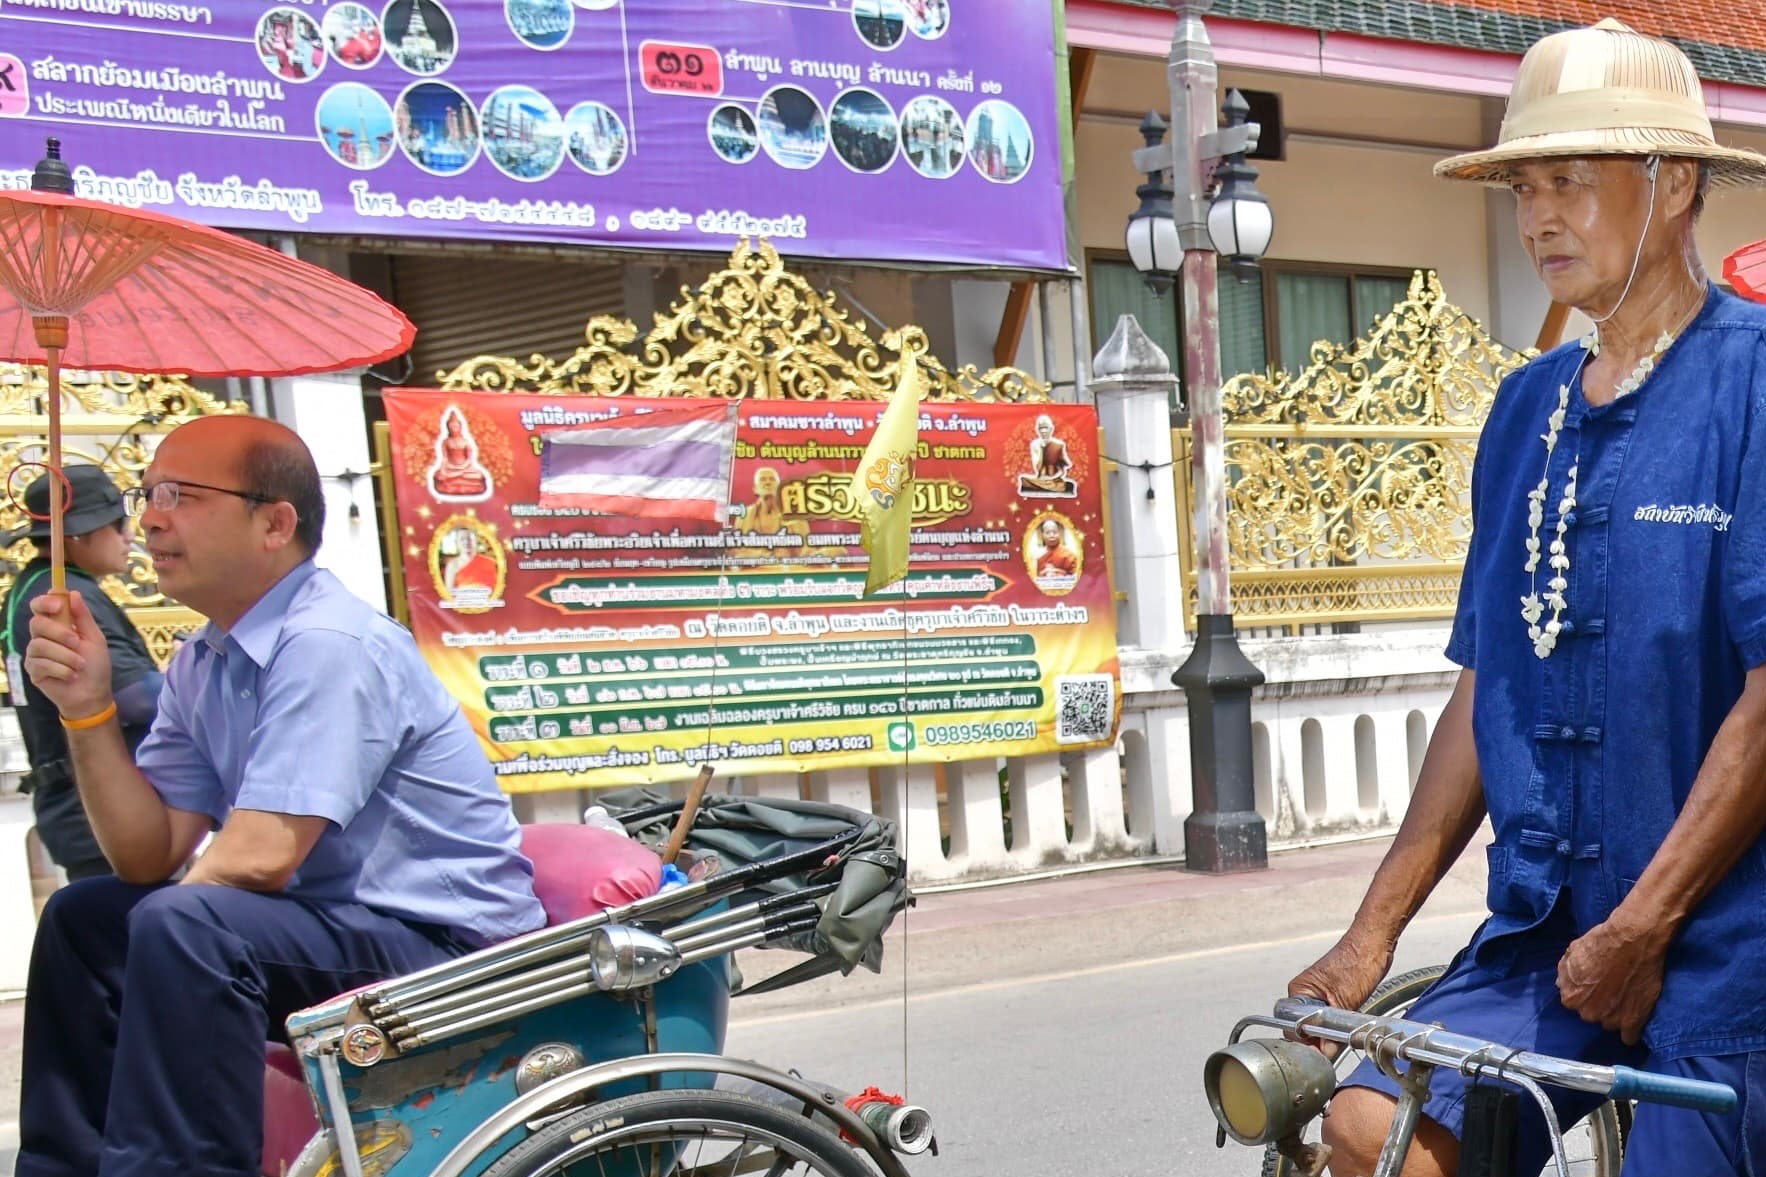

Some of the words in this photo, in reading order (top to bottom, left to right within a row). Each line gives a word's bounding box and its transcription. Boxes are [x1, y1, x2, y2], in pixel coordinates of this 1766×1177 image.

[725, 49, 782, 82] ลำพูน
[790, 60, 861, 89] ลานบุญ
[868, 62, 931, 88] ล้านนา
[178, 173, 322, 219] จังหวัดลำพูน
[781, 472, 970, 522] ศรีวิชนะ
[925, 721, 1036, 745] 0989546021
[496, 748, 648, 776] ามเพื่อร่วมบุญและสั่งจอง
[789, 740, 813, 754] 098
[816, 739, 839, 751] 954
[842, 736, 872, 750] 6021
